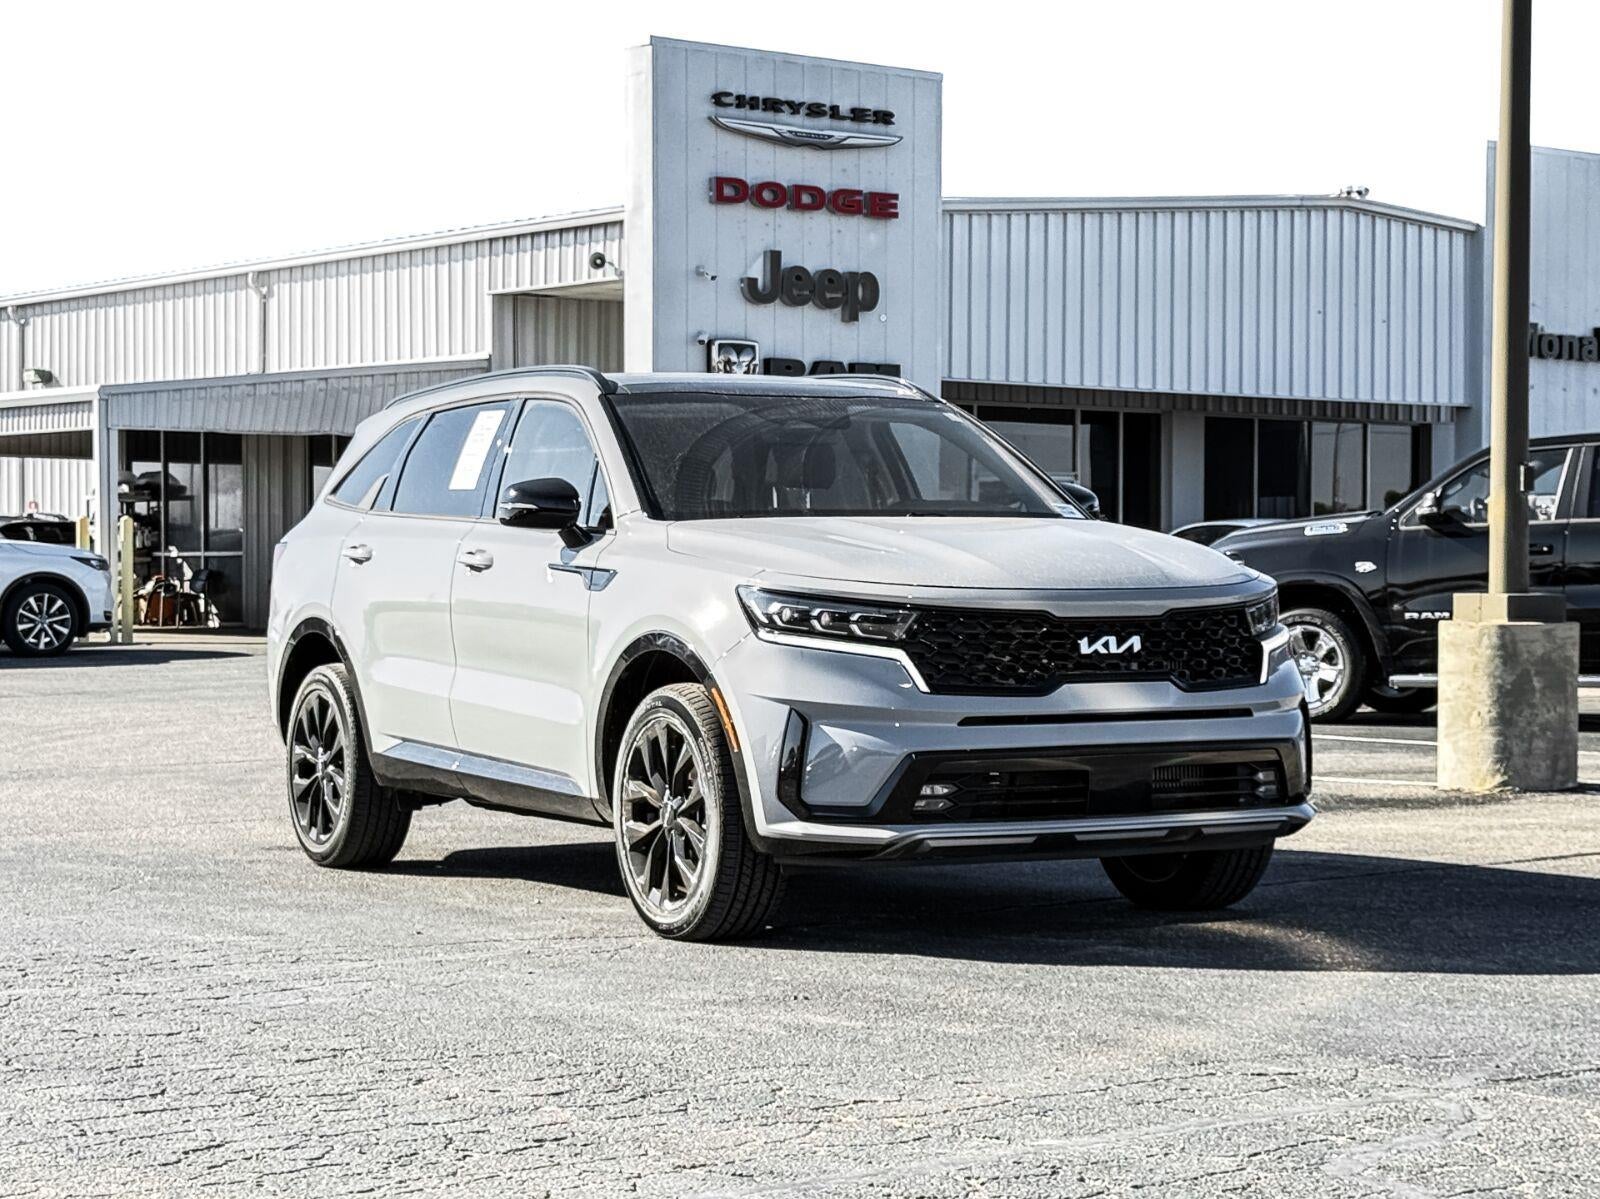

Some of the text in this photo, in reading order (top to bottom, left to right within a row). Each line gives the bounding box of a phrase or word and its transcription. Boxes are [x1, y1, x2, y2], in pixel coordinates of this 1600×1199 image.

[710, 91, 896, 126] CHRYSLER
[709, 176, 900, 219] DODGE
[740, 250, 880, 323] Jeep
[1404, 611, 1451, 620] RAM
[1077, 635, 1142, 655] KIA
